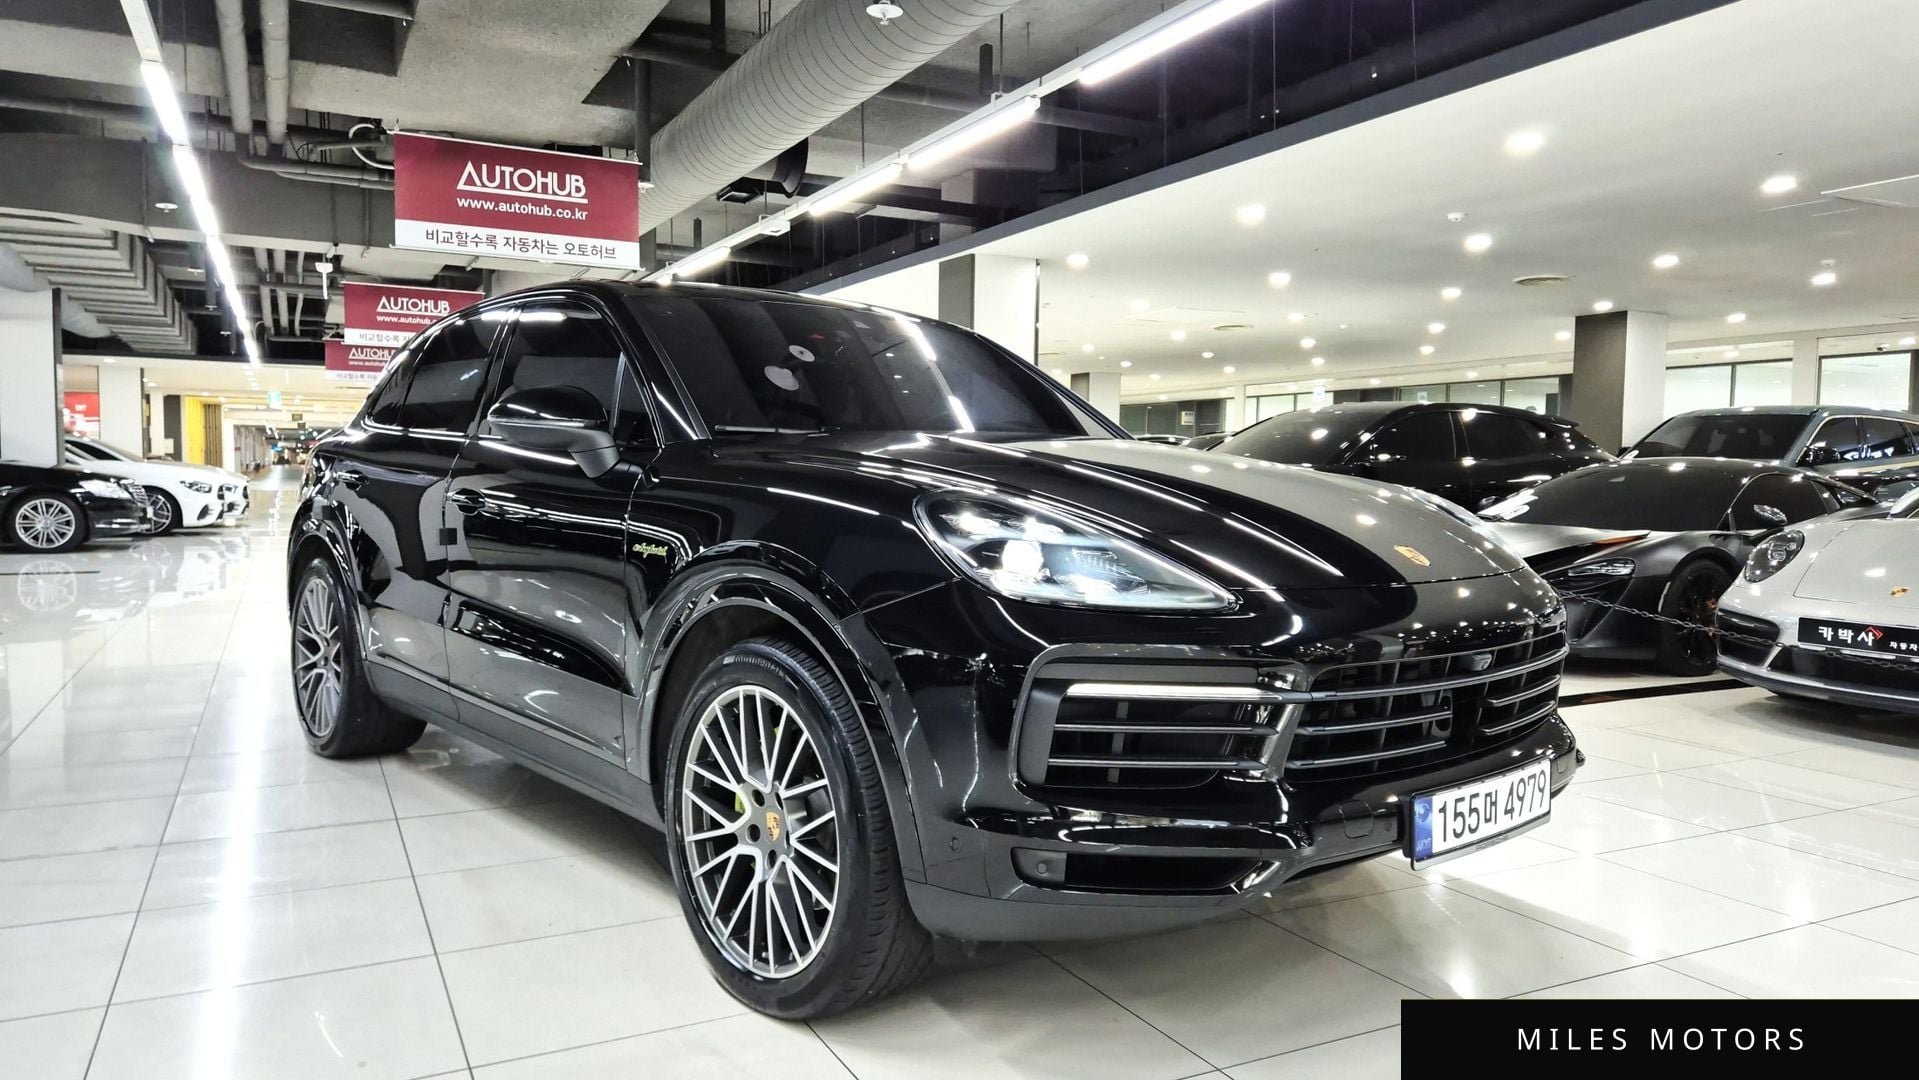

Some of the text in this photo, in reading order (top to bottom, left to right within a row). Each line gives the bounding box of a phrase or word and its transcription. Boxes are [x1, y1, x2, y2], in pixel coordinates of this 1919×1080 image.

[456, 160, 588, 203] AUTOHUB
[457, 197, 588, 220] www.autohub.co.kr
[425, 228, 617, 260] 비교할수록 자동차는 오토허브
[376, 296, 450, 316] AUTOHUB
[348, 347, 396, 360] AUTOHU
[1818, 626, 1875, 647] 카박사
[1438, 769, 1547, 842] 155머 4979
